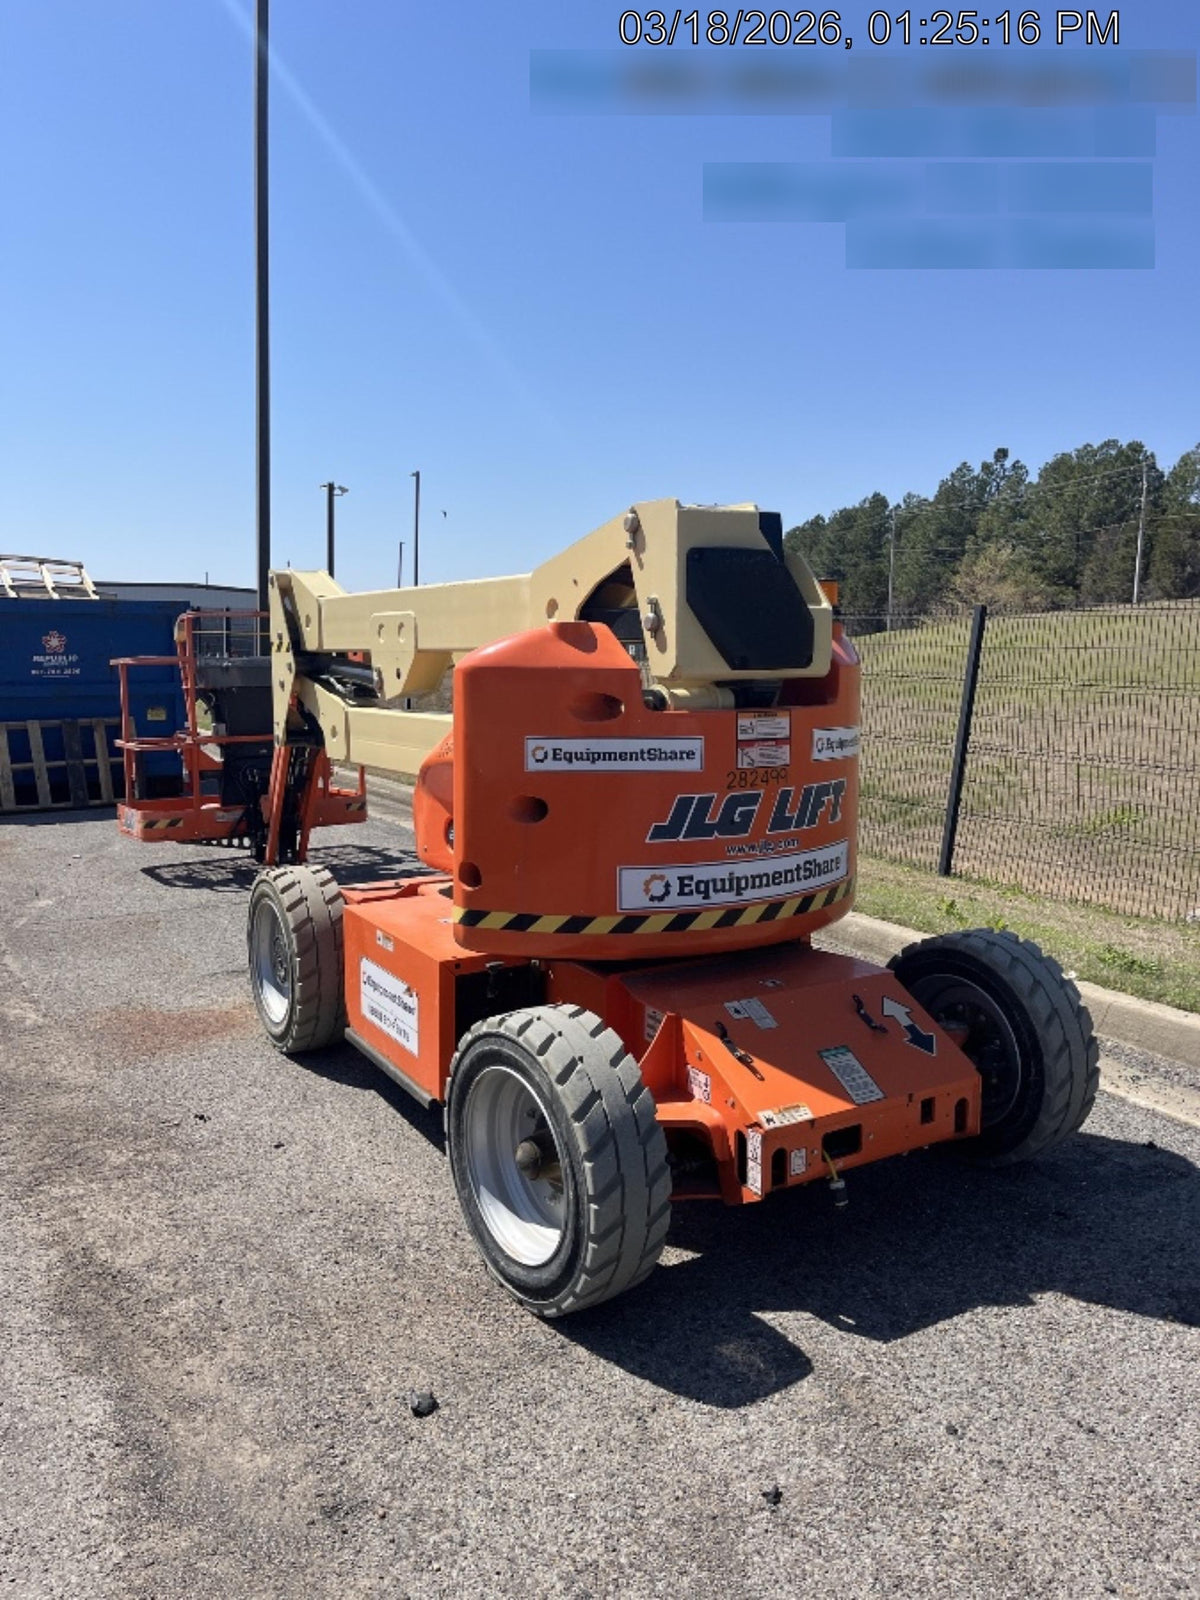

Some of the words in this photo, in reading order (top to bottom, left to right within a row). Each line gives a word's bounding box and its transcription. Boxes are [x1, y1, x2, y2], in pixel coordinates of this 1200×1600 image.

[551, 747, 696, 765] EquipmentShare
[726, 768, 789, 790] 282499
[645, 790, 764, 843] JLG
[766, 778, 847, 835] LIFT
[677, 856, 842, 900] EquipmentShare
